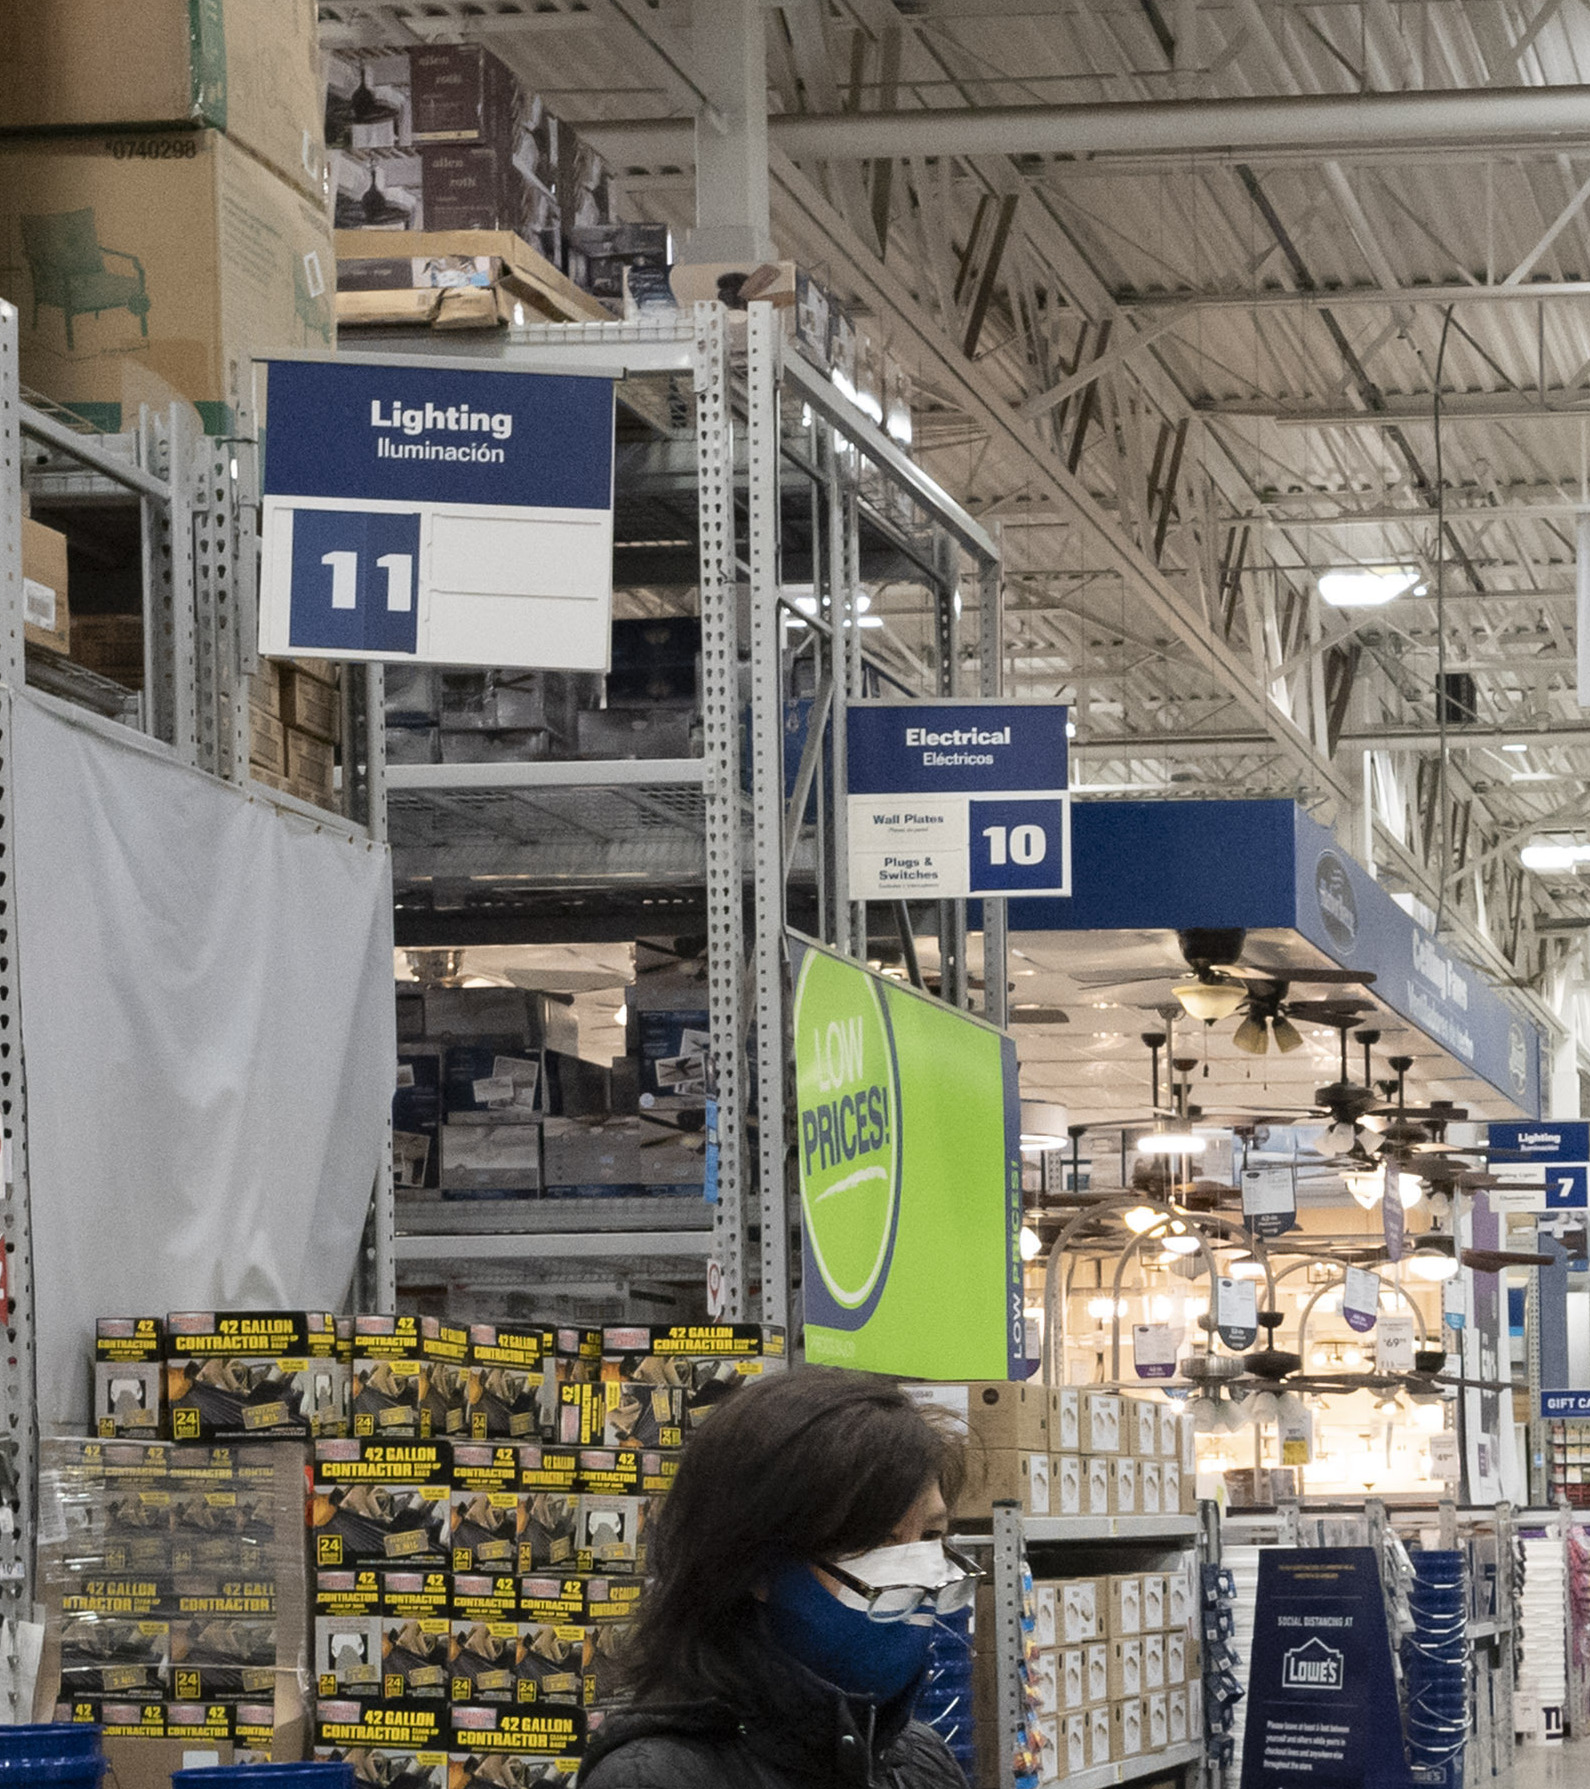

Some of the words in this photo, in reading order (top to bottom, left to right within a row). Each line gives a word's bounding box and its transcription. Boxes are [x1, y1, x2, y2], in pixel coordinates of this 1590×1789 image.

[370, 400, 513, 439] Lighting
[377, 436, 506, 465] Iluminación
[320, 550, 413, 612] 11
[906, 726, 1011, 747] Electrical
[922, 751, 995, 767] Eléctricos
[873, 813, 901, 826] Wall
[904, 813, 944, 826] Plates
[982, 824, 1047, 866] 10
[883, 857, 920, 870] Plugs
[923, 857, 933, 867] &
[878, 869, 939, 881] Switches
[813, 1015, 864, 1092] LOW
[802, 1085, 890, 1176] PRICES!
[1518, 1132, 1561, 1144] Lighting
[1557, 1178, 1575, 1198] 7
[1010, 1161, 1022, 1285] PRICES!
[1012, 1293, 1022, 1360] LOW
[1547, 1398, 1577, 1410] GIFT
[364, 1447, 383, 1461] 42
[386, 1447, 436, 1462] GALLON
[321, 1462, 413, 1478] CONTRACTOR
[320, 1538, 340, 1551] 24
[1289, 1656, 1339, 1684] LOWE'S
[365, 1711, 383, 1725] 42
[385, 1712, 435, 1727] GALLON
[501, 1717, 519, 1732] 42
[521, 1718, 573, 1733] GALLON
[322, 1725, 410, 1741] CONTRACTOR
[457, 1732, 548, 1748] CONTRACTOR
